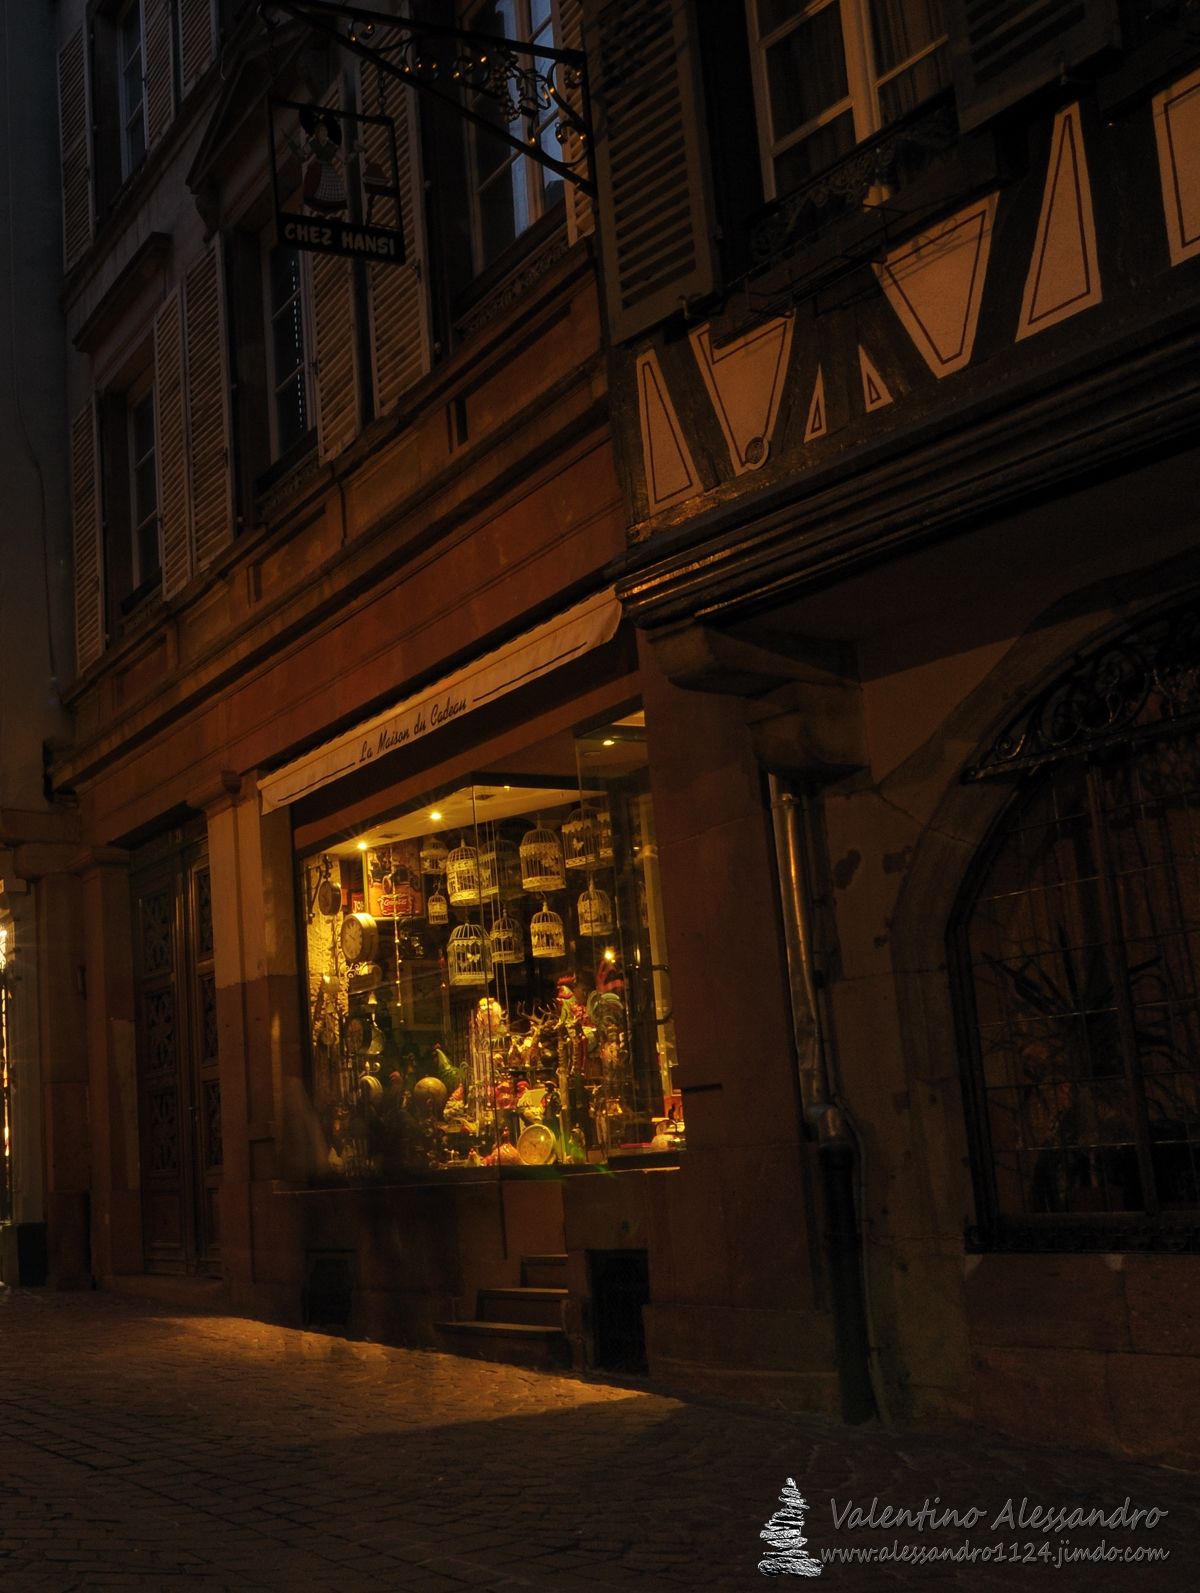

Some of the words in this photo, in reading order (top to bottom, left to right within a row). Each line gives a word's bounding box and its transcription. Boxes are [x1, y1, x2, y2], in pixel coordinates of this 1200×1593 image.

[285, 223, 332, 245] CHEZ
[342, 231, 395, 255] HANSI
[360, 741, 373, 761] La
[378, 731, 410, 753] Maison
[414, 712, 426, 734] du
[431, 697, 466, 725] Cadeau
